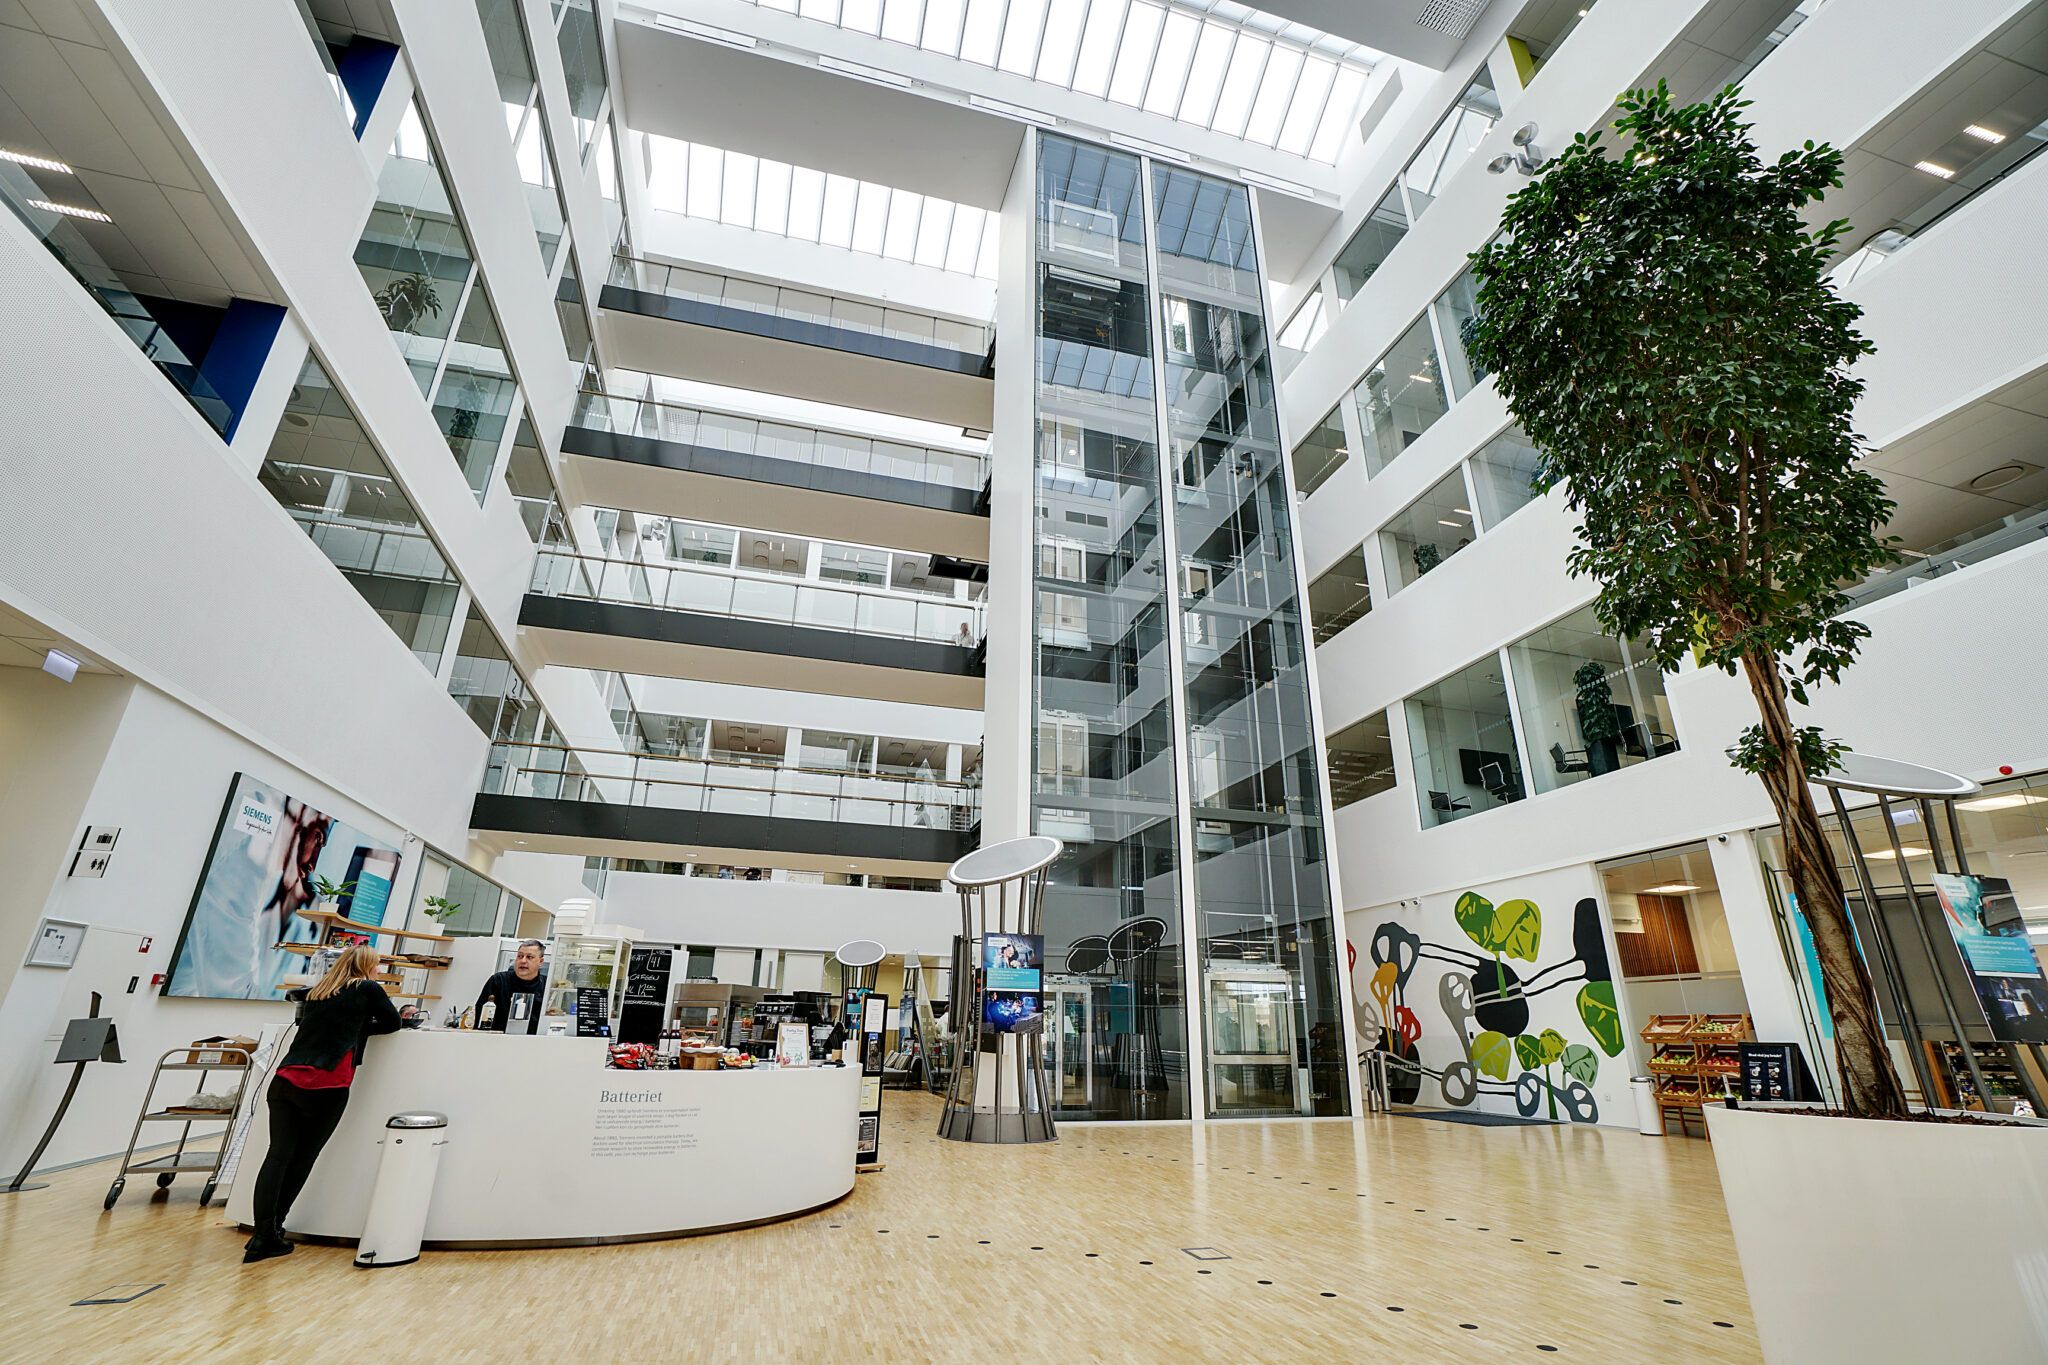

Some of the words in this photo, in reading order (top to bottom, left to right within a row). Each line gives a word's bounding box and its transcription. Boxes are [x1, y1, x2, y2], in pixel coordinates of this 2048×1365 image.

[243, 805, 272, 825] SIEMENS
[650, 956, 661, 968] 41
[600, 1090, 662, 1103] Batteriet
